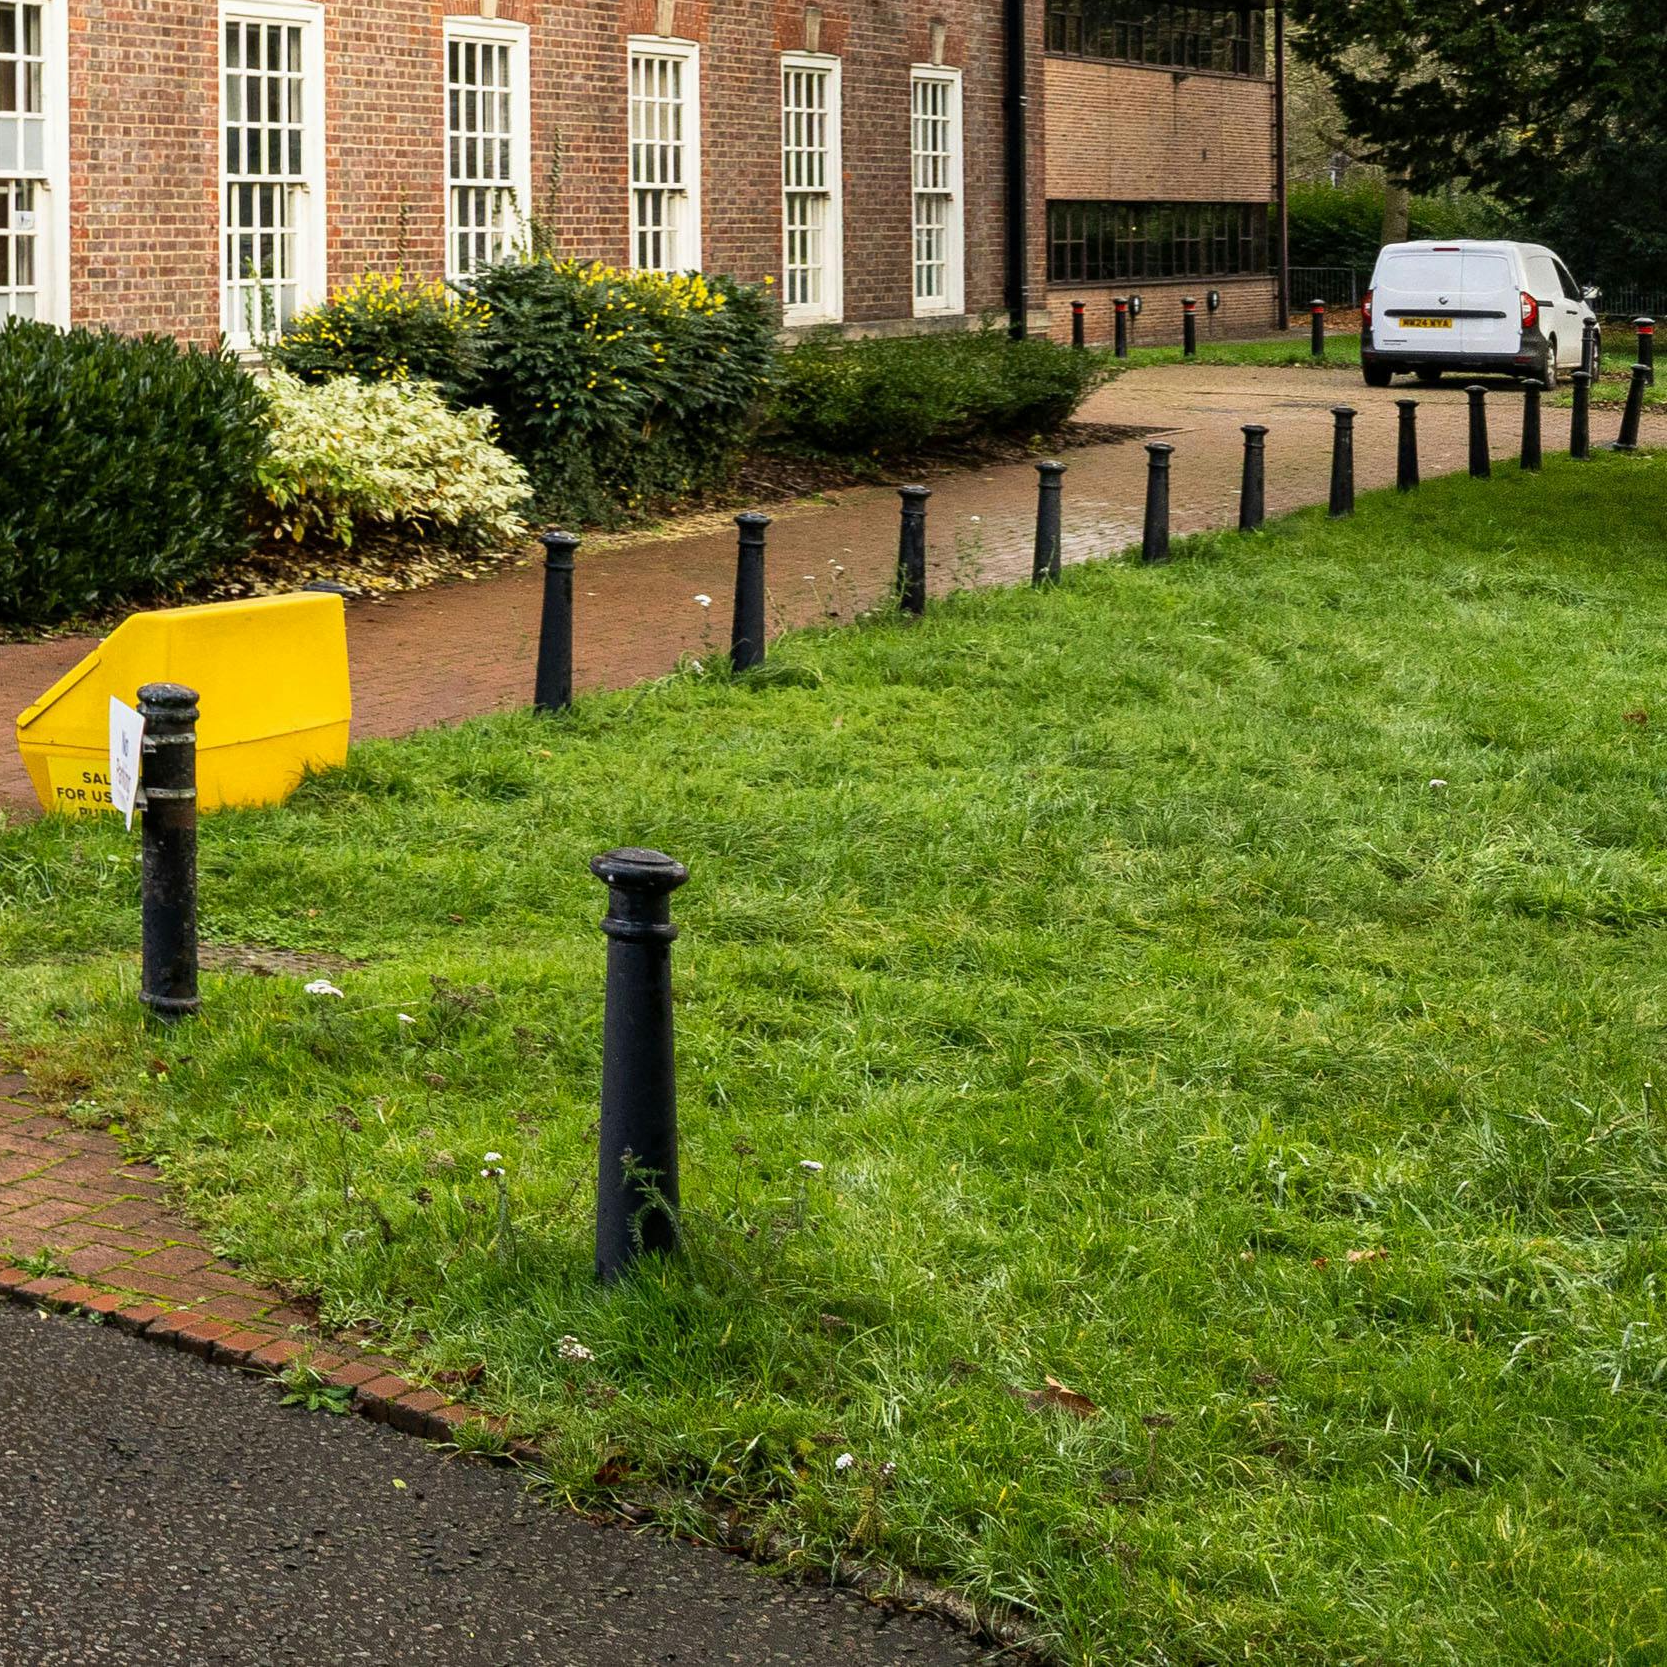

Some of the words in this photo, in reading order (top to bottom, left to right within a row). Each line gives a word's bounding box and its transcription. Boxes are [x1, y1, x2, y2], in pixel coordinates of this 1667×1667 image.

[83, 771, 111, 785] SAL
[57, 787, 87, 801] FOR
[92, 790, 113, 803] US
